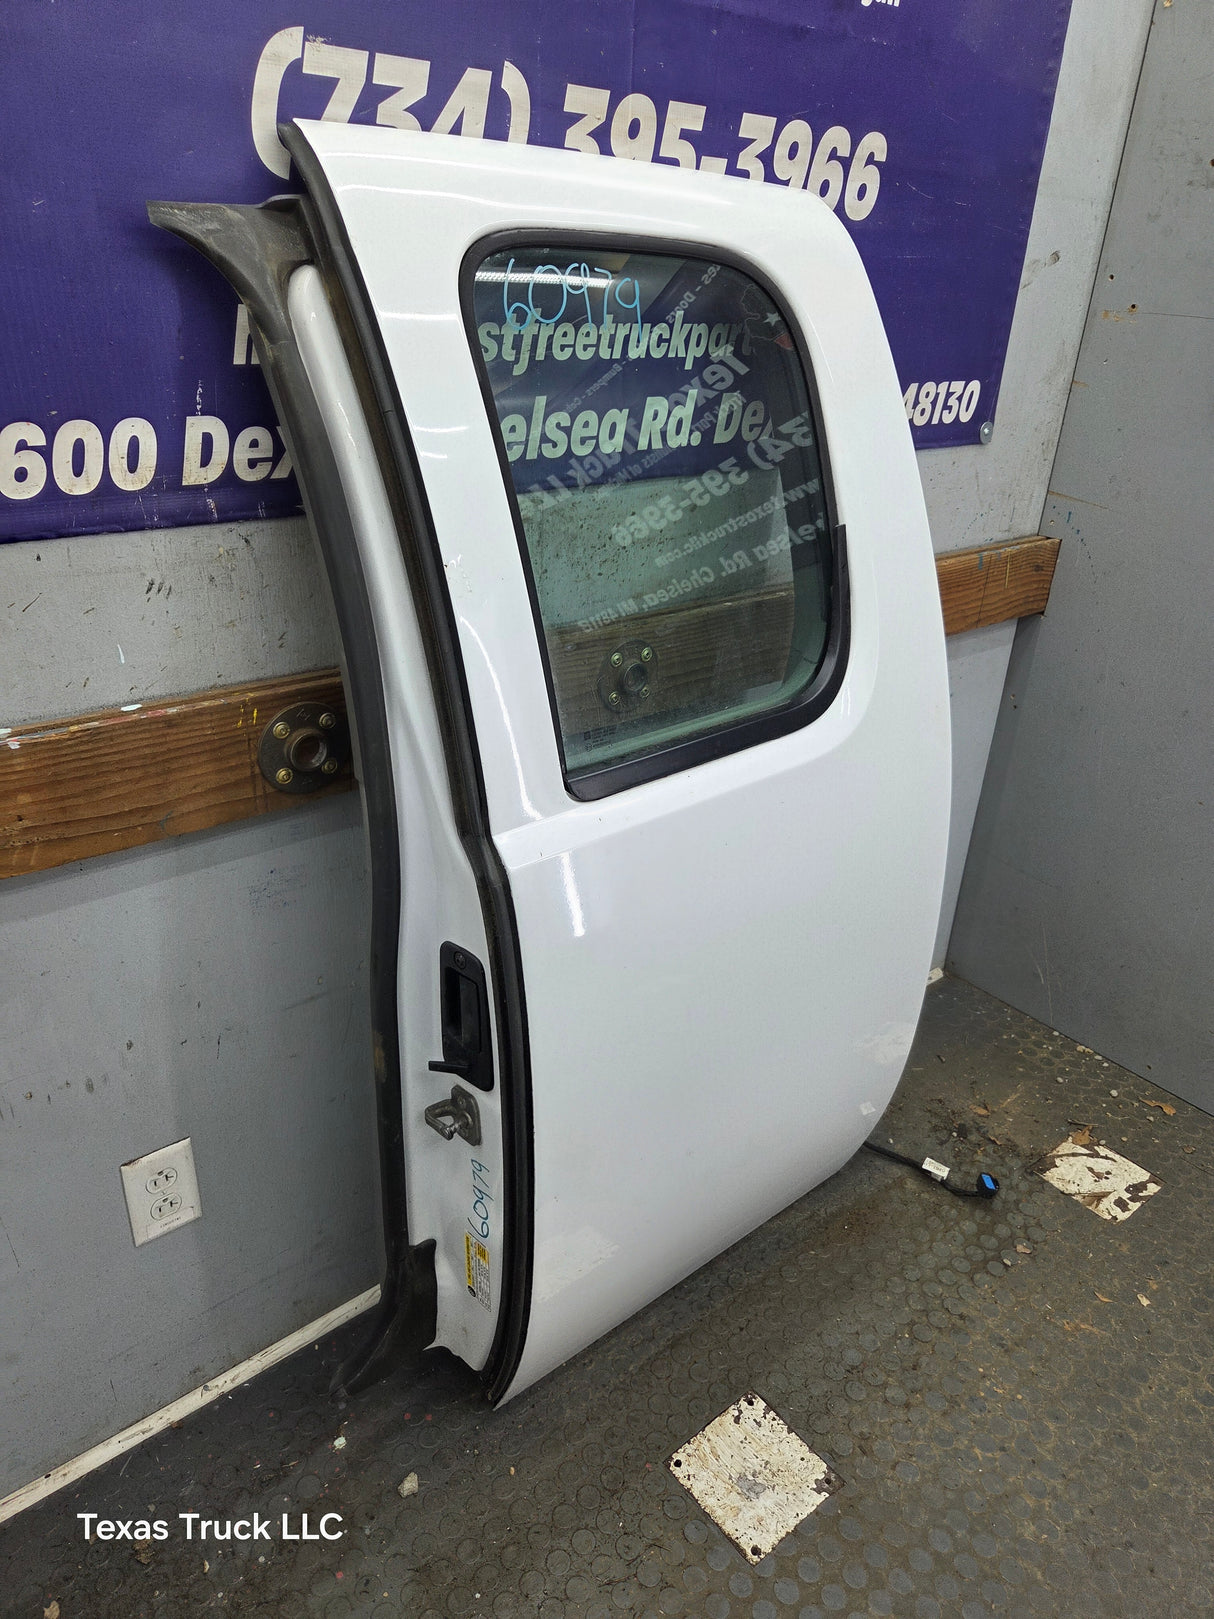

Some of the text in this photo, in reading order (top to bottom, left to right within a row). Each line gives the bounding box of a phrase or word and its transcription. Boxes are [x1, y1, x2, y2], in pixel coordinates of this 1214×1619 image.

[251, 26, 888, 221] (734) 395-3966
[503, 258, 643, 344] 60979
[0, 421, 158, 500] 600
[637, 389, 702, 452] Rd.
[903, 380, 981, 427] 48130
[468, 1158, 495, 1241] 60979
